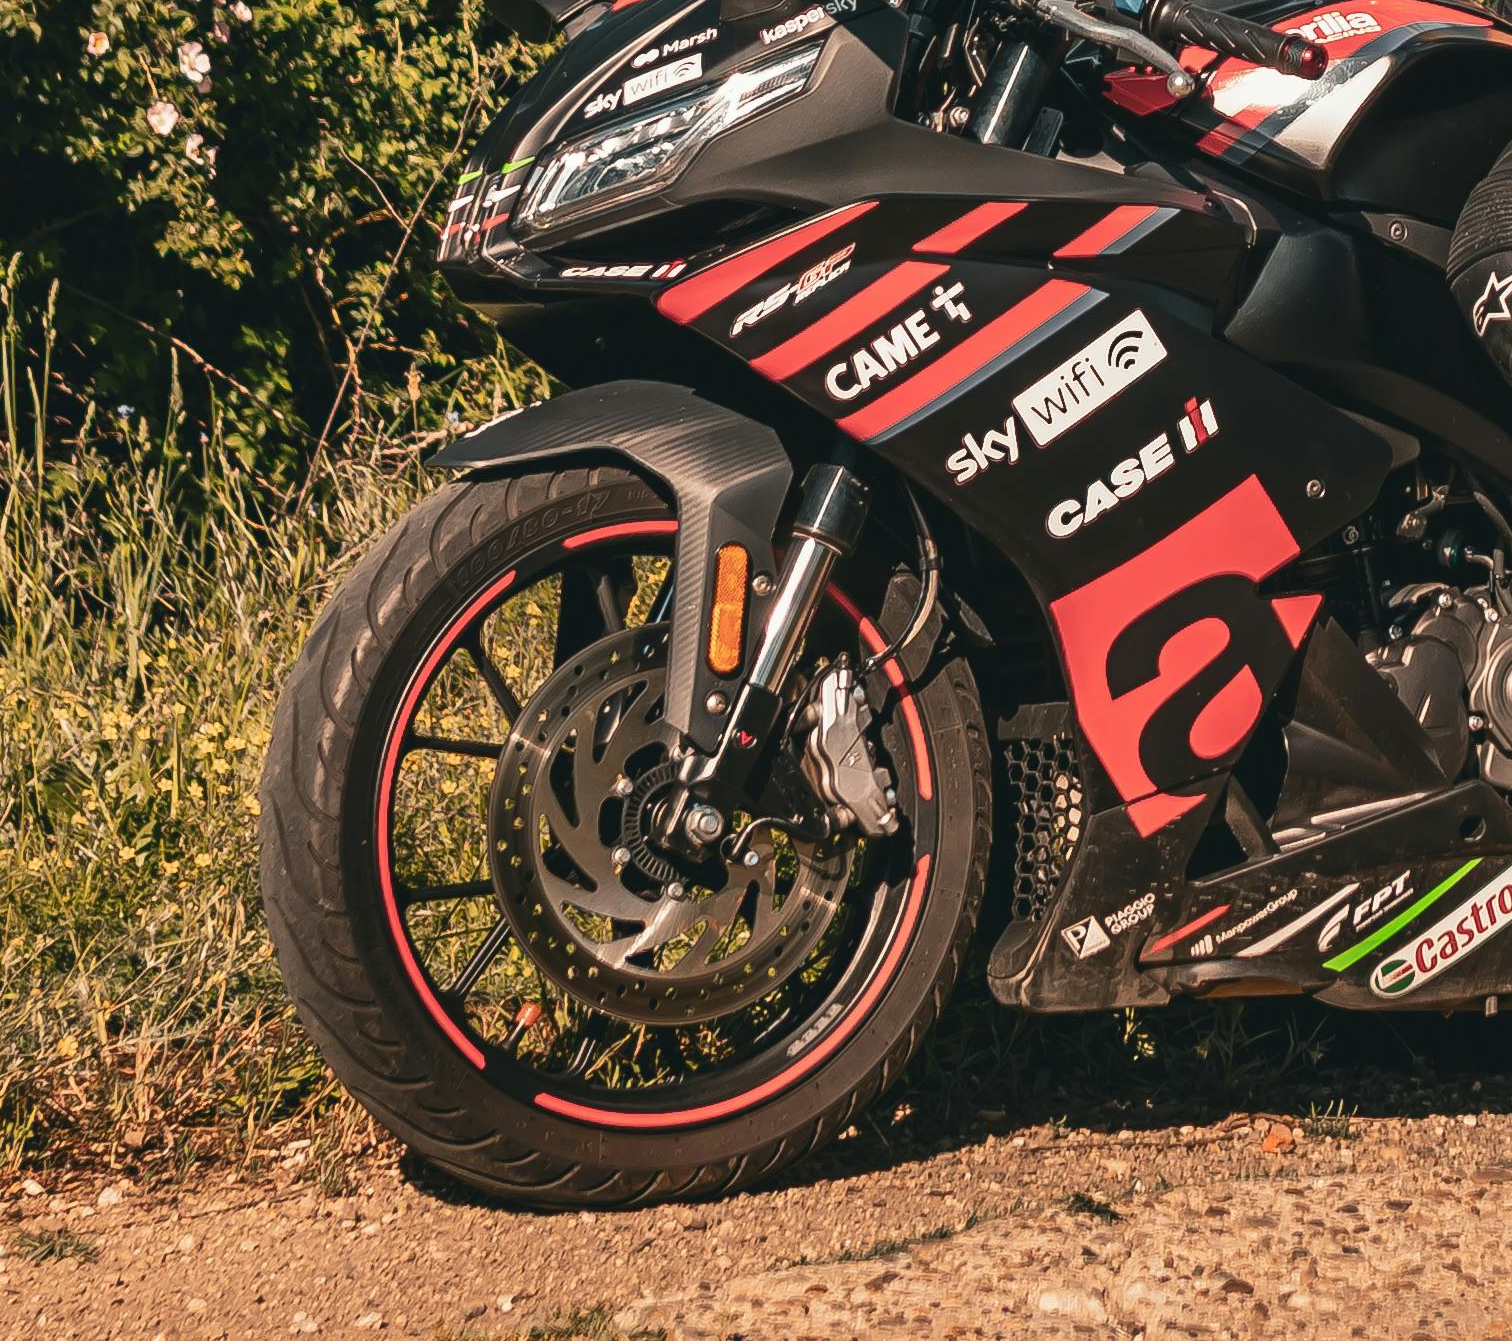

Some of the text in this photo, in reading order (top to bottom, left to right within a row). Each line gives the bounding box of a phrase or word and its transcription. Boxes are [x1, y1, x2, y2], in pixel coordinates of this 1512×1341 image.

[662, 27, 718, 57] Marsh
[584, 67, 669, 119] sky wifi
[559, 264, 653, 279] CASE
[825, 308, 941, 400] CAME
[947, 356, 1106, 485] sky wifi
[1046, 432, 1176, 539] CASE
[1104, 892, 1157, 929] PIAGGIO
[1110, 903, 1156, 935] GROUP
[1214, 888, 1298, 945] ManpowerGroup
[1353, 869, 1412, 927] FPT
